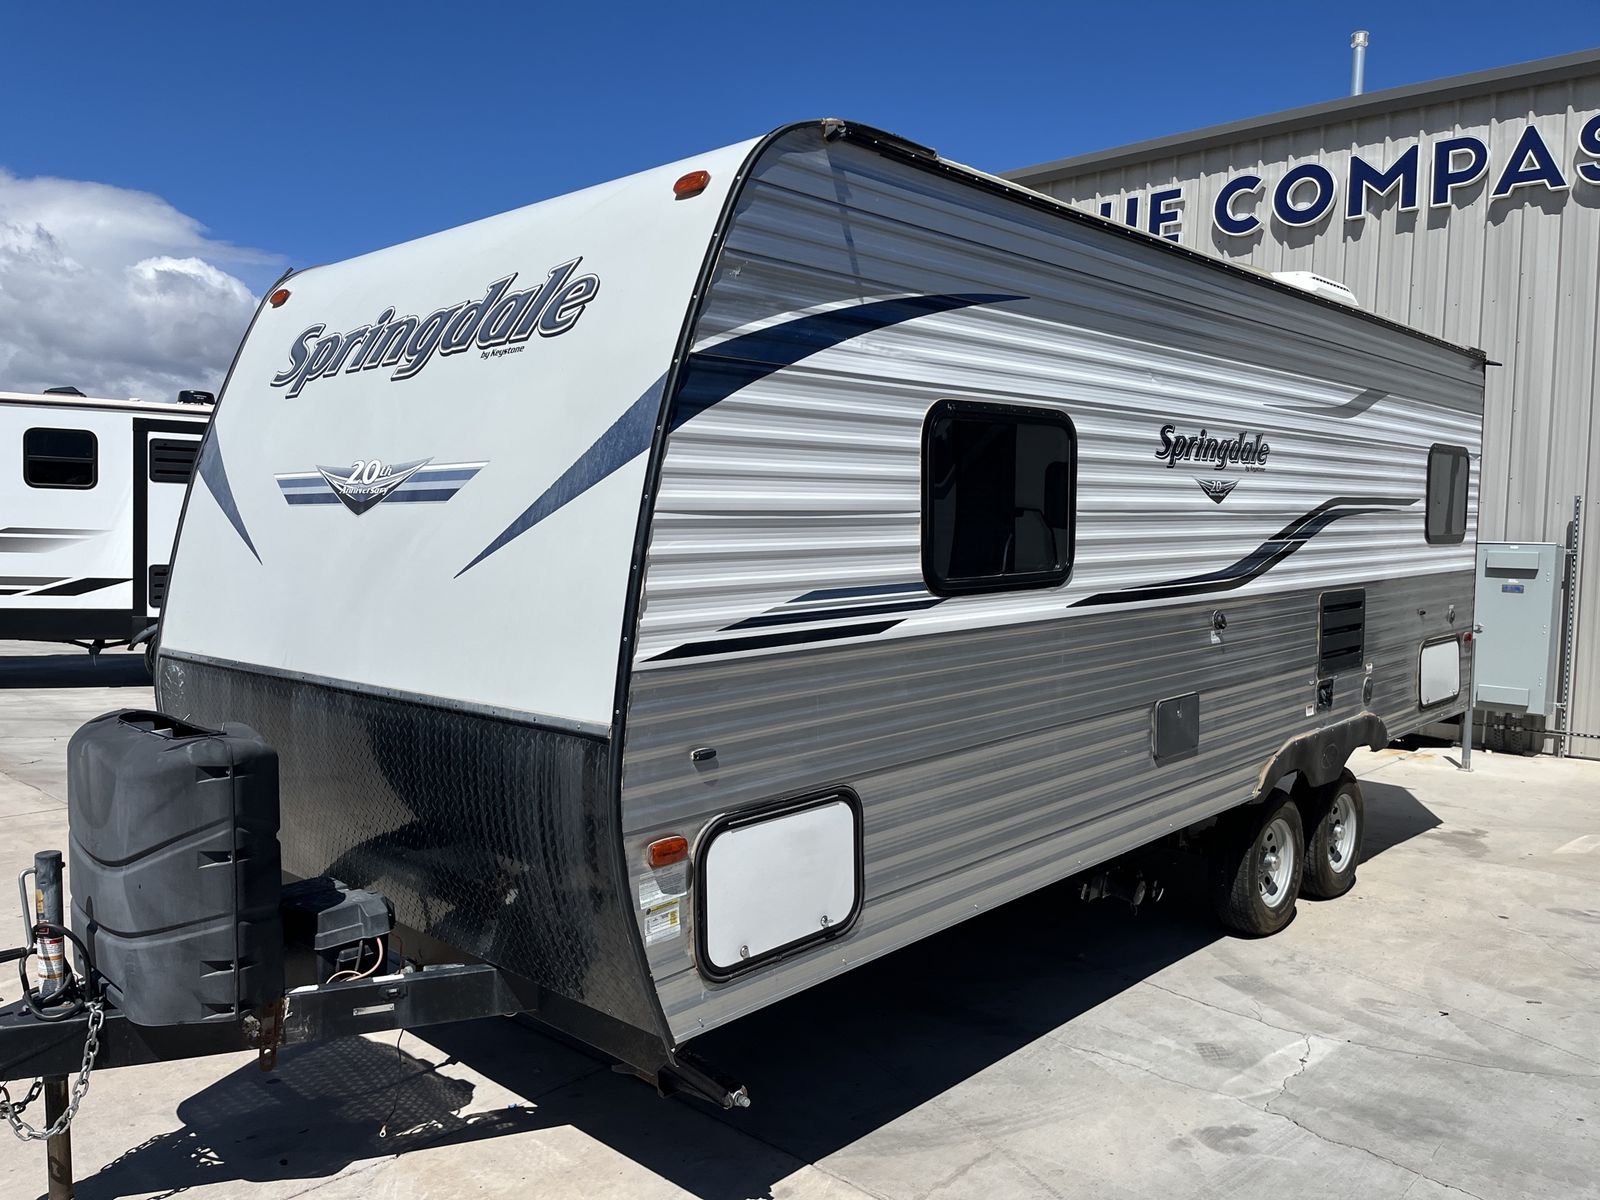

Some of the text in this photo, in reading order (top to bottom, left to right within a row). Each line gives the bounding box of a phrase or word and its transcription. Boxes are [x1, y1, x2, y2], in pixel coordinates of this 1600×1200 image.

[269, 256, 601, 399] Springdale
[481, 346, 525, 360] by Keystone
[1155, 424, 1271, 471] Springdale
[345, 459, 393, 485] 20th
[339, 485, 390, 496] Anniversary
